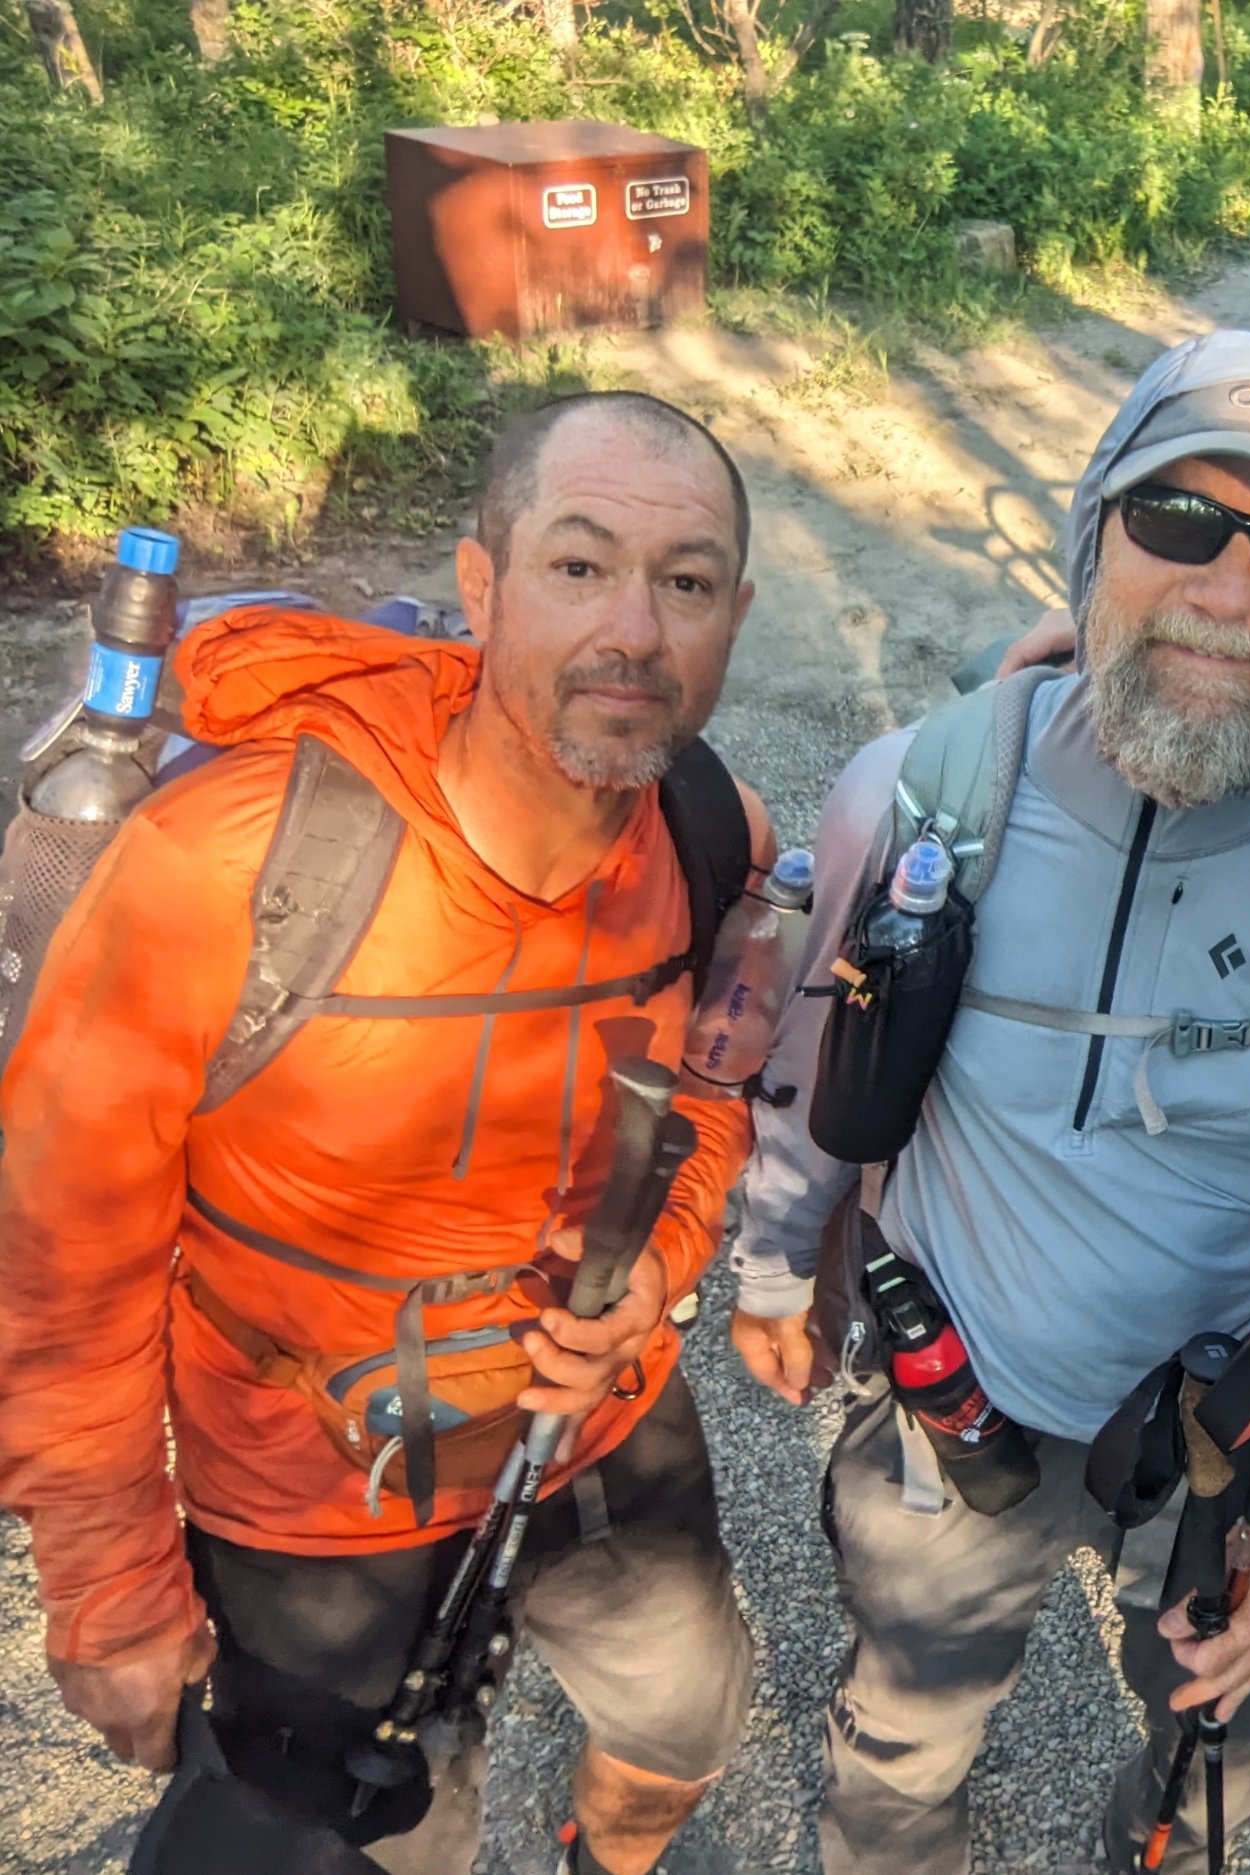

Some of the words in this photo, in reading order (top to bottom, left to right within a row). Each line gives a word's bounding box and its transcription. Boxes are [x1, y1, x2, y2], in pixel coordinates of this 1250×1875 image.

[652, 183, 681, 196] Trash
[645, 196, 686, 210] Garbage
[115, 660, 141, 713] Sawyer
